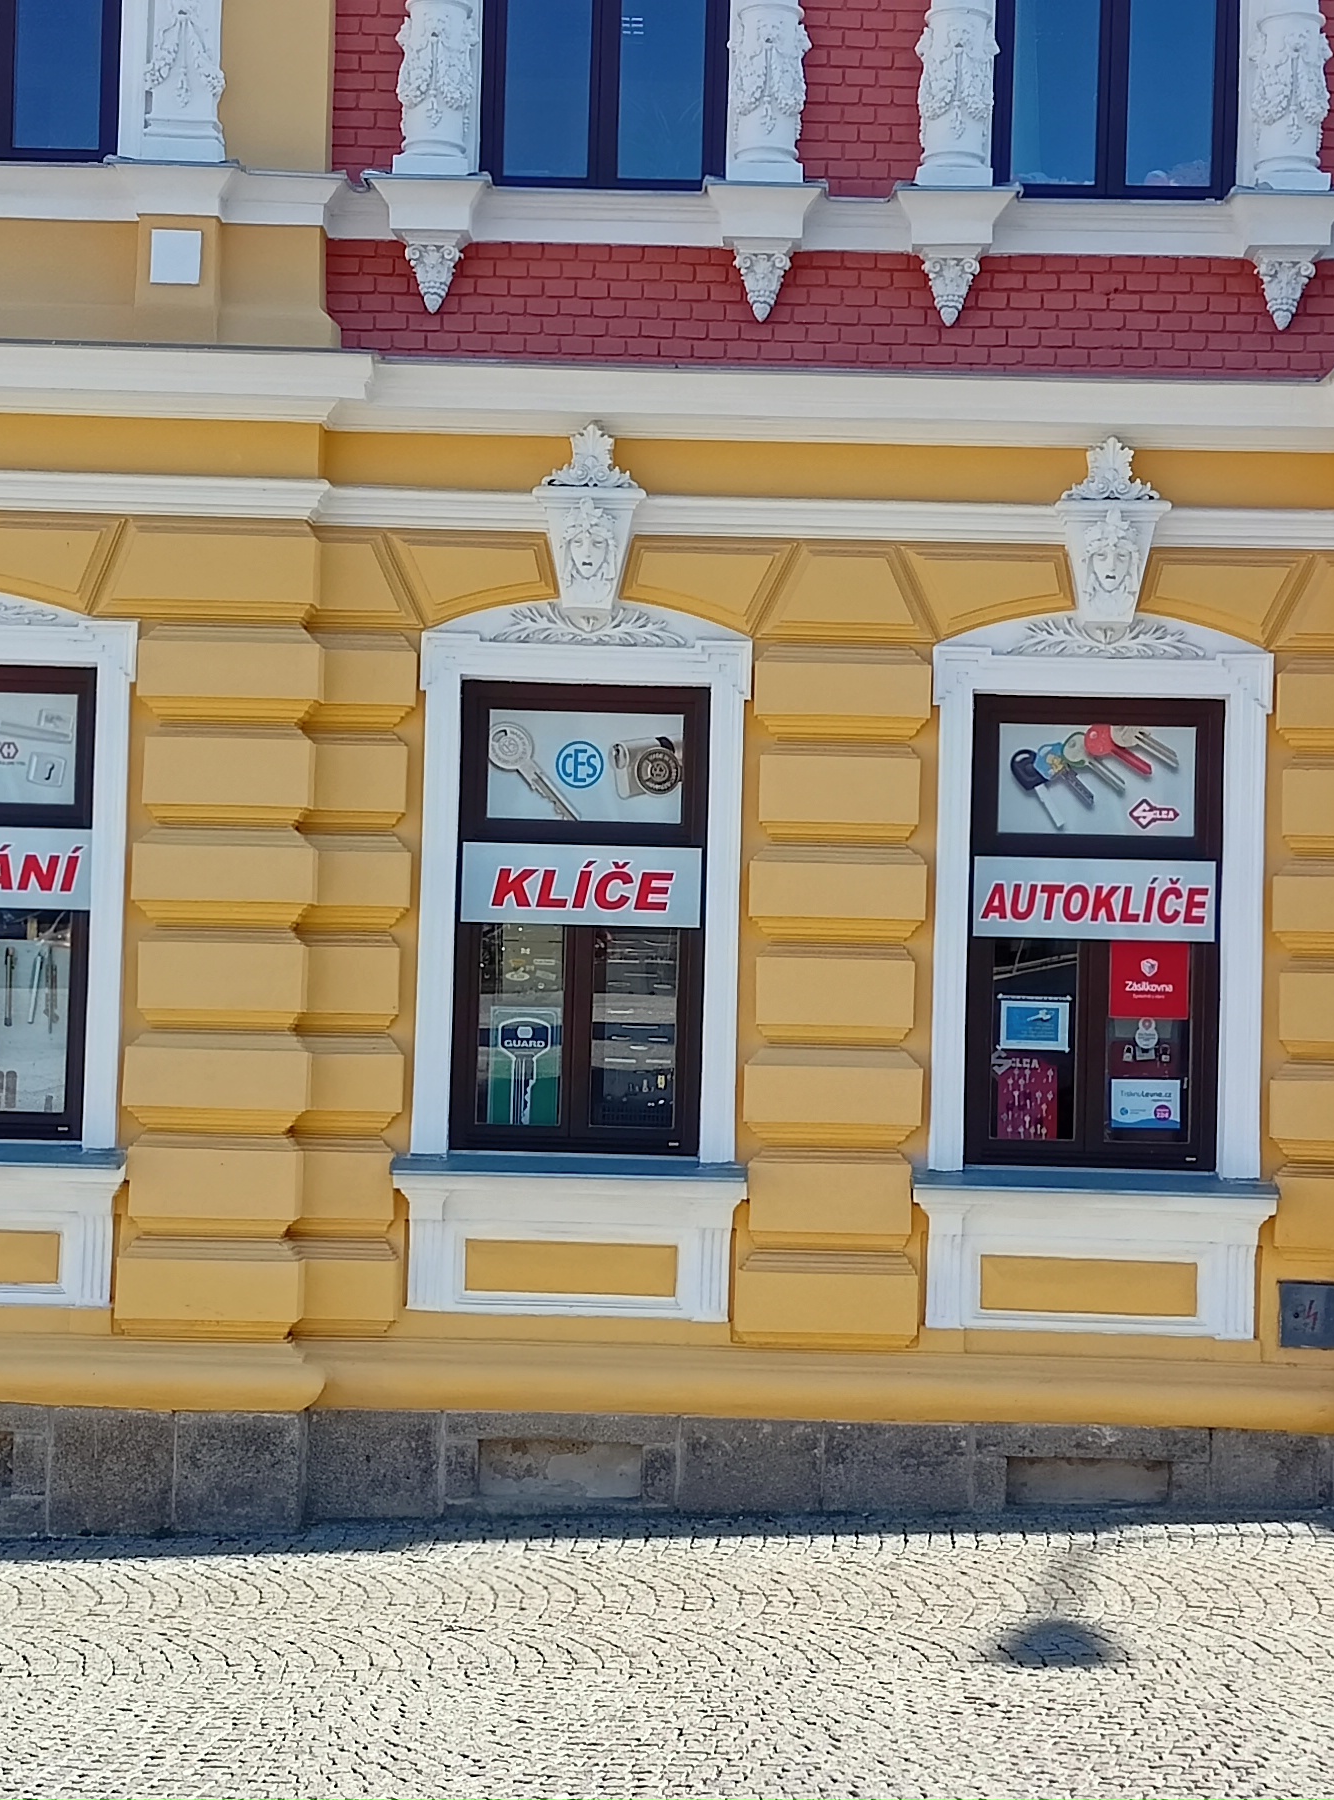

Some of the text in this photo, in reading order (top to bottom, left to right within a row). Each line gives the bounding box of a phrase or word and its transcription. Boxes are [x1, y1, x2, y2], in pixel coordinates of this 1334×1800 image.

[561, 748, 598, 782] CES
[490, 860, 675, 911] KLÍČE
[980, 876, 1210, 925] AUTOKLÍČE
[1124, 980, 1174, 993] Zásilkovna
[503, 1038, 546, 1049] GUARD
